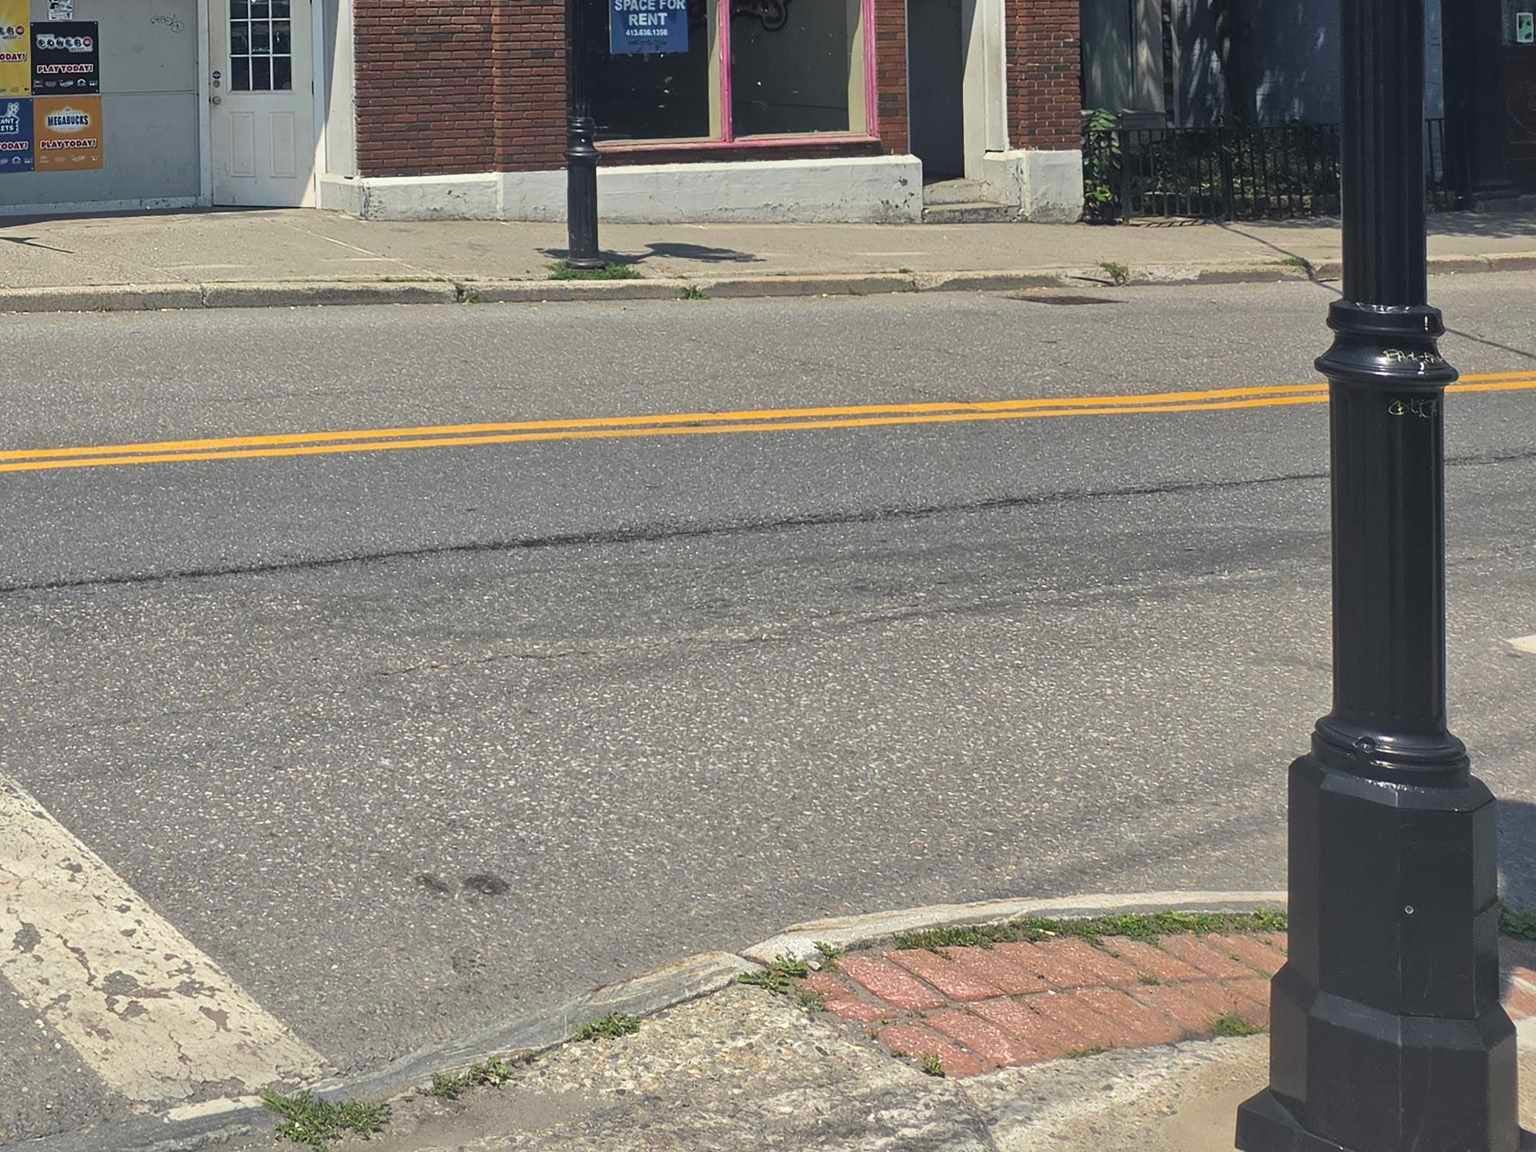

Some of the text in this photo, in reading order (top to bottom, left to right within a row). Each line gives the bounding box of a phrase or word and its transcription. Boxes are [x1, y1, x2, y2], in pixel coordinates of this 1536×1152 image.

[629, 12, 668, 26] RENT
[37, 63, 94, 74] PLAY TODAY!
[47, 114, 89, 126] MEGABUCKS
[40, 138, 96, 150] PLAY TODAY!
